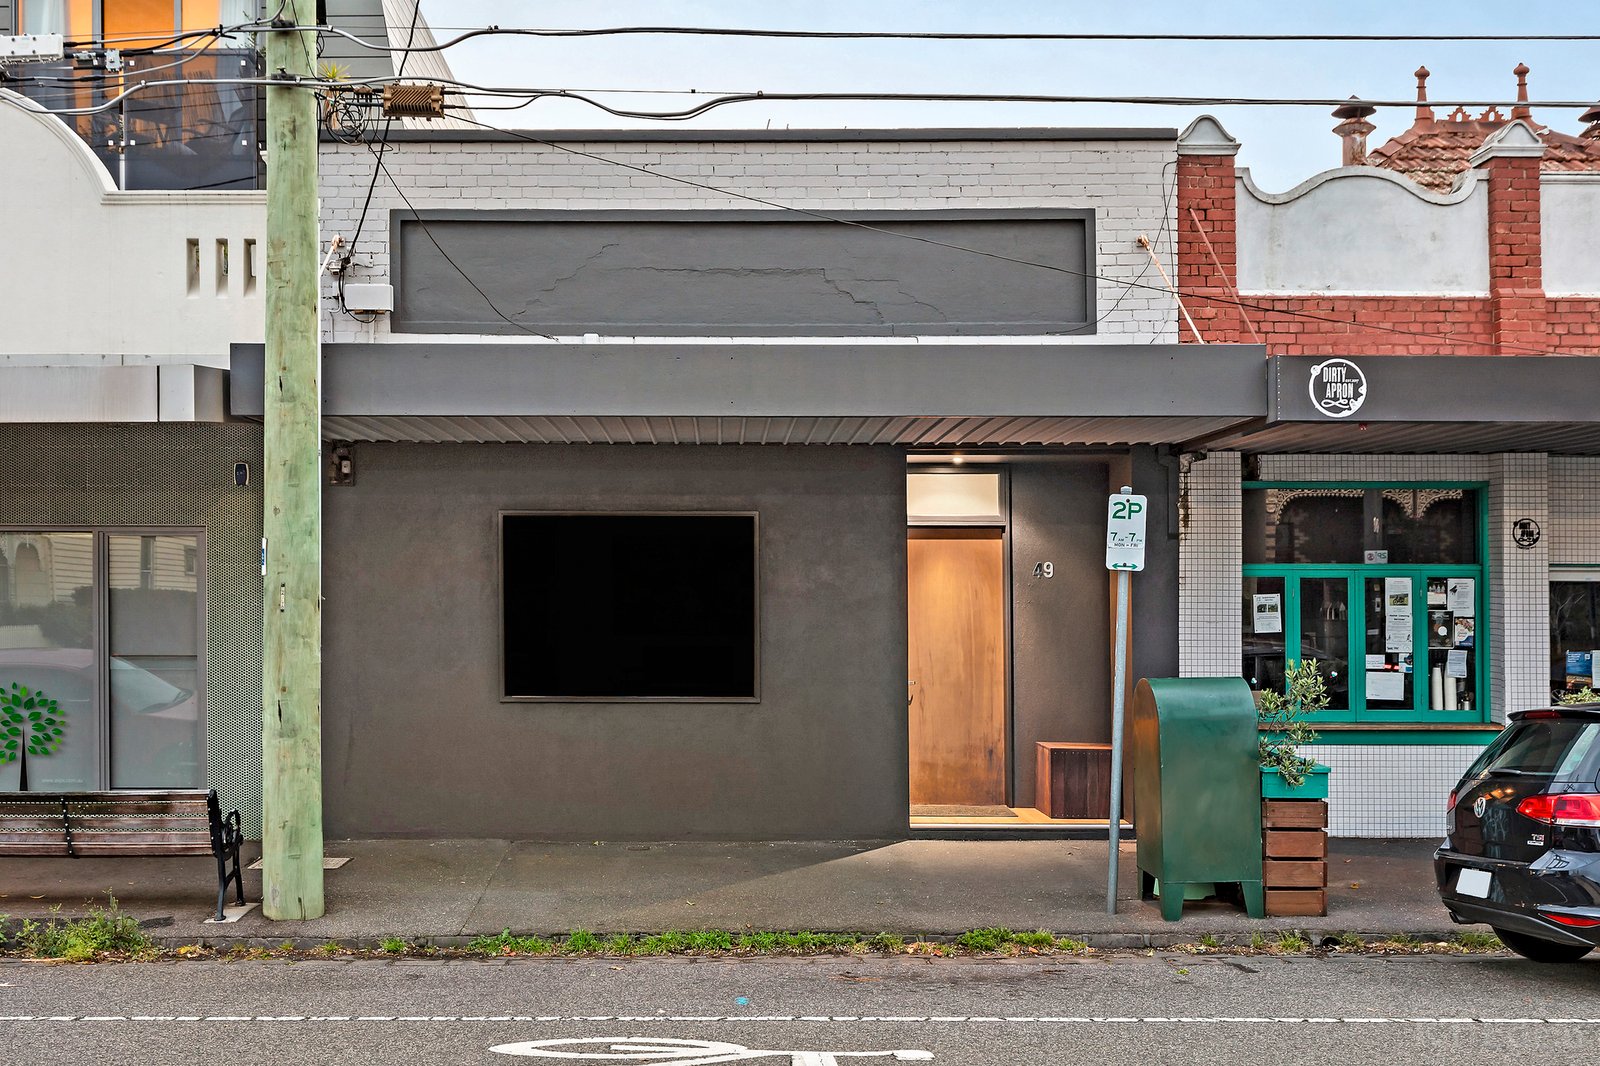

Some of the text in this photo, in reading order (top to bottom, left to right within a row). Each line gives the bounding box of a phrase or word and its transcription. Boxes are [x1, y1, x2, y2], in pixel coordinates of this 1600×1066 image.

[1323, 366, 1347, 382] DIRTY
[1325, 383, 1354, 398] APRON
[1112, 501, 1142, 520] 2P
[1032, 561, 1054, 578] 49
